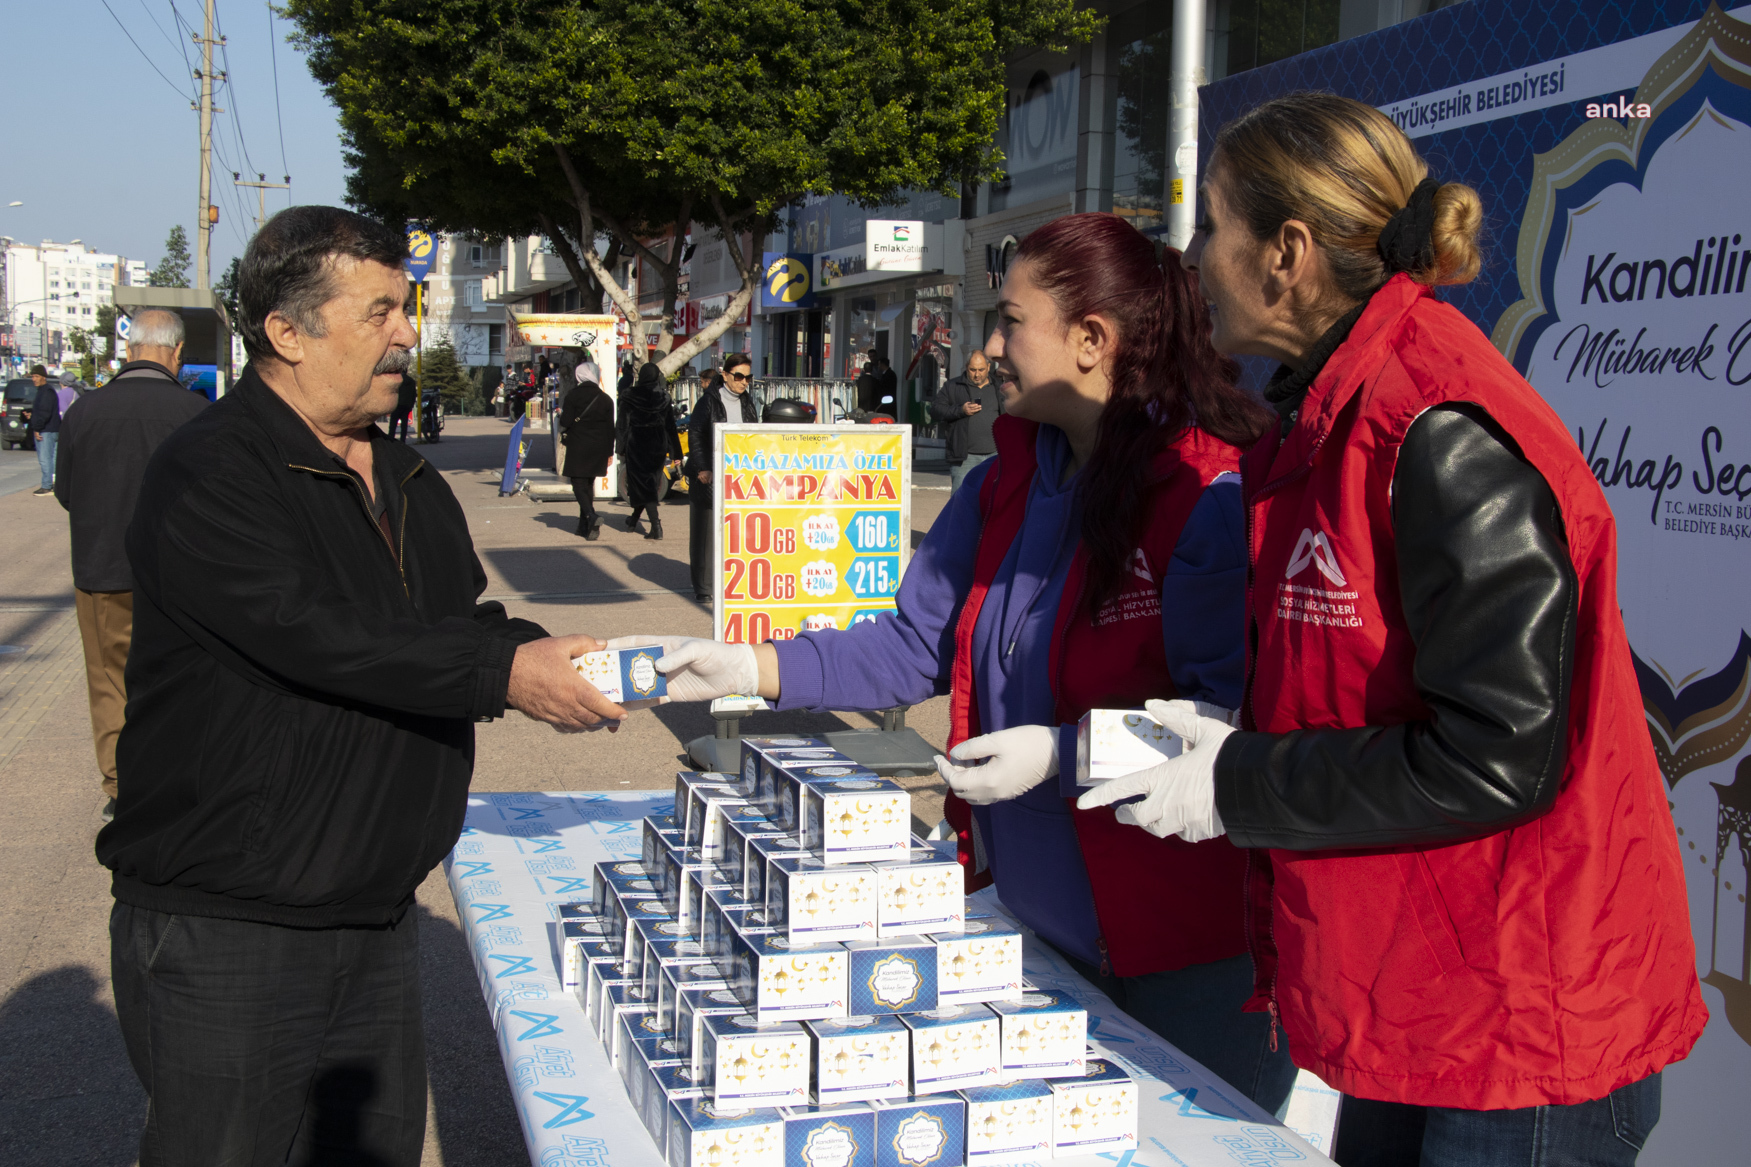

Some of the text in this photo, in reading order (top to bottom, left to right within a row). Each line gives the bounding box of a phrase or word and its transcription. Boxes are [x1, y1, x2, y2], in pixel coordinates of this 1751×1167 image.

[1391, 63, 1566, 130] ÜYÜKŞEHİR BELEDİYESİ
[1553, 323, 1719, 388] Mübarek
[799, 434, 829, 442] Telekom
[724, 448, 897, 471] MAĞAZAMIZA ÖZEL
[1578, 417, 1751, 526] Vahap Seç
[724, 474, 898, 501] KAMPANYA
[1665, 501, 1684, 514] T.C.
[1687, 502, 1733, 517] MERSİN
[825, 522, 834, 530] AY
[1664, 518, 1717, 535] BELEDİYE
[823, 568, 833, 576] AY
[1304, 599, 1356, 615] HİZMETLERİ
[1277, 608, 1363, 627] DAİREİ BAŞKANLIĞI
